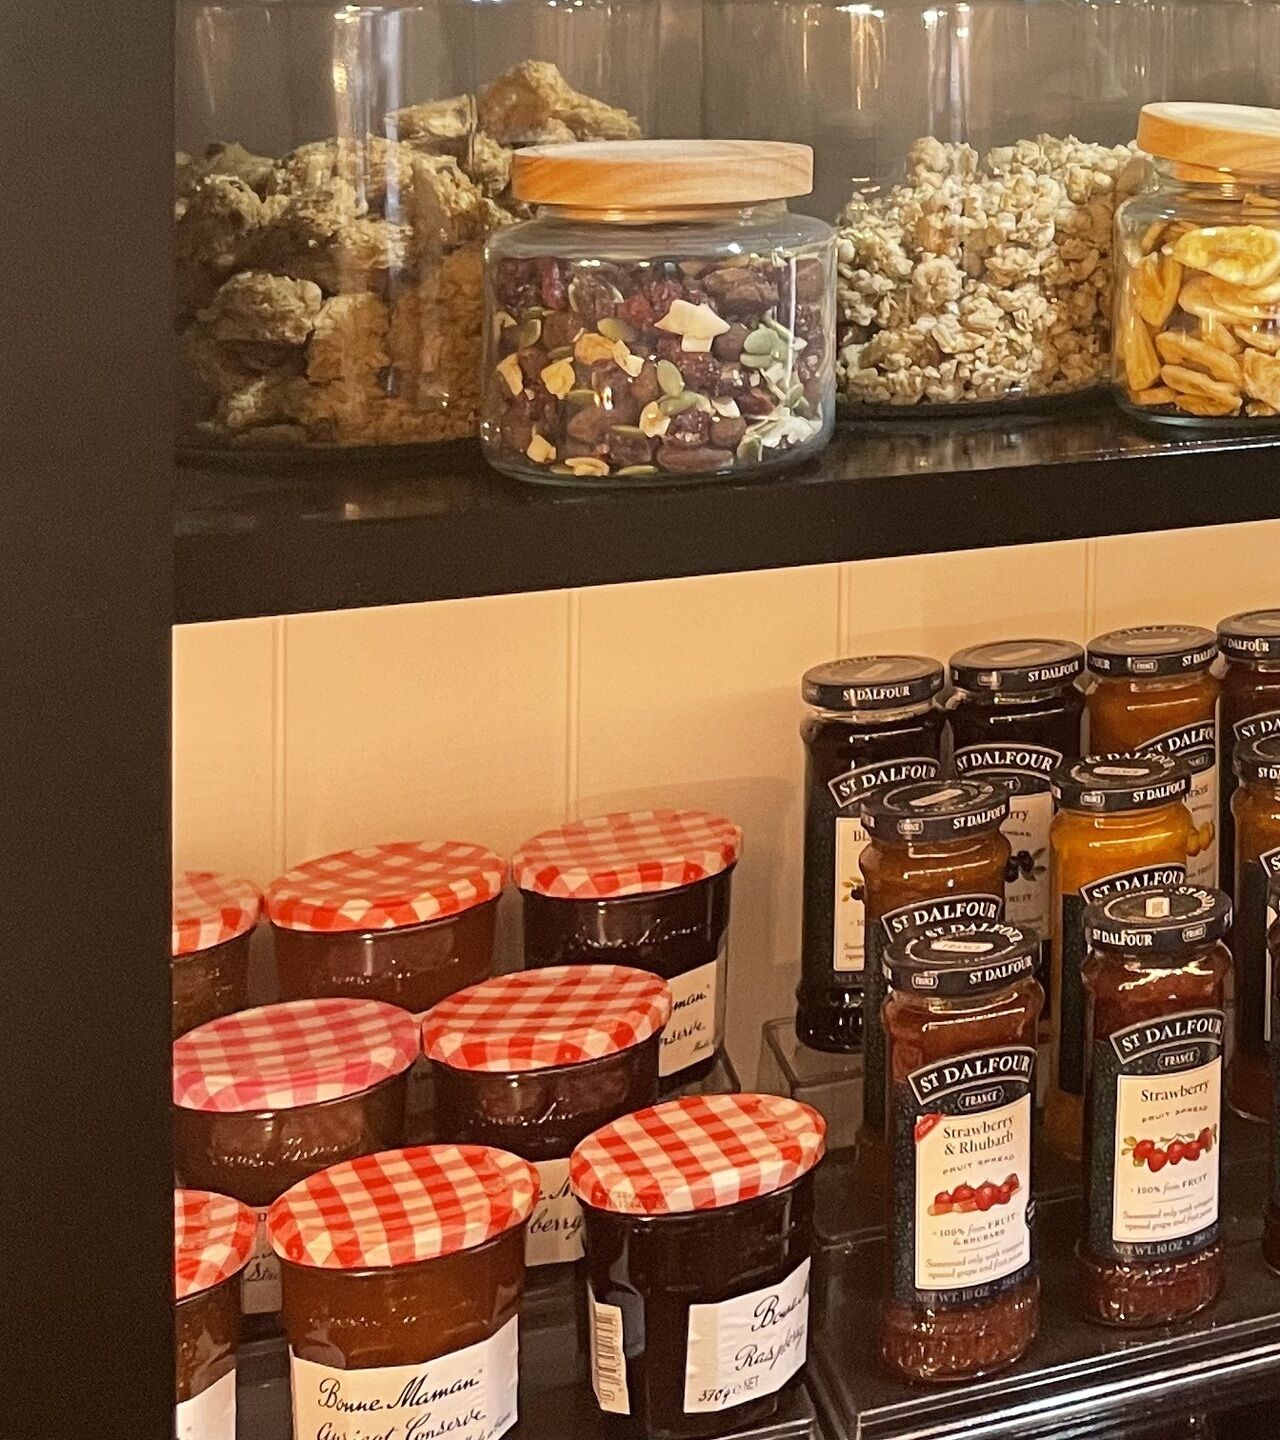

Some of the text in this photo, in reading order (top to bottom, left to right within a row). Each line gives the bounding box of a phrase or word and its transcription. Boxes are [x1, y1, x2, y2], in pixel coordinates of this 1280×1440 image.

[970, 751, 1053, 772] DALFOUR
[914, 902, 997, 926] DALFOUR
[1102, 931, 1153, 946] DALFOUR
[1122, 1018, 1222, 1052] ST DALFOUR
[1164, 1051, 1195, 1066] FRANCE
[920, 1055, 1031, 1093] ST DALFOUR
[965, 1091, 998, 1106] FRANCE
[1140, 1080, 1209, 1102] Strawberry
[943, 1115, 1015, 1139] Strawberry
[944, 1130, 1013, 1156] & Rhubarb
[318, 1373, 480, 1413] Bonne Maman
[743, 1375, 760, 1391] NET
